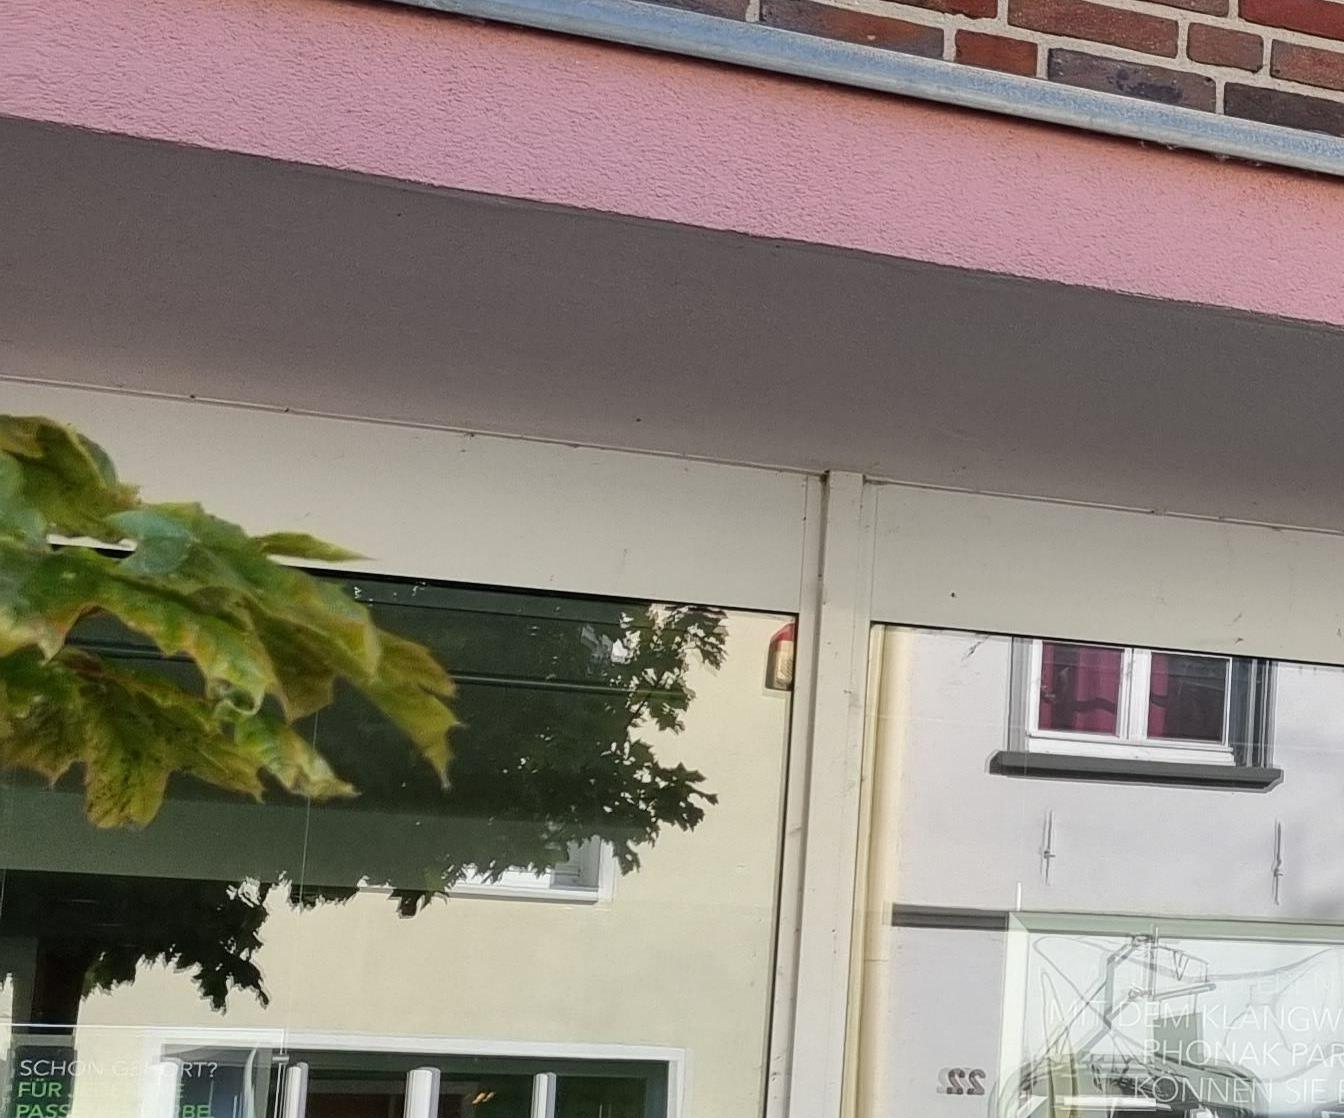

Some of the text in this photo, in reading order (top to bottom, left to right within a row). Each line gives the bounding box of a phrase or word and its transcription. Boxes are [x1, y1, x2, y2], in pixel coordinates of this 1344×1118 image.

[1049, 1000, 1103, 1027] MIT
[1119, 1001, 1194, 1029] DEM
[1143, 1039, 1285, 1068] PHONAK
[17, 1077, 62, 1098] FÜR
[1287, 1078, 1328, 1105] SIE
